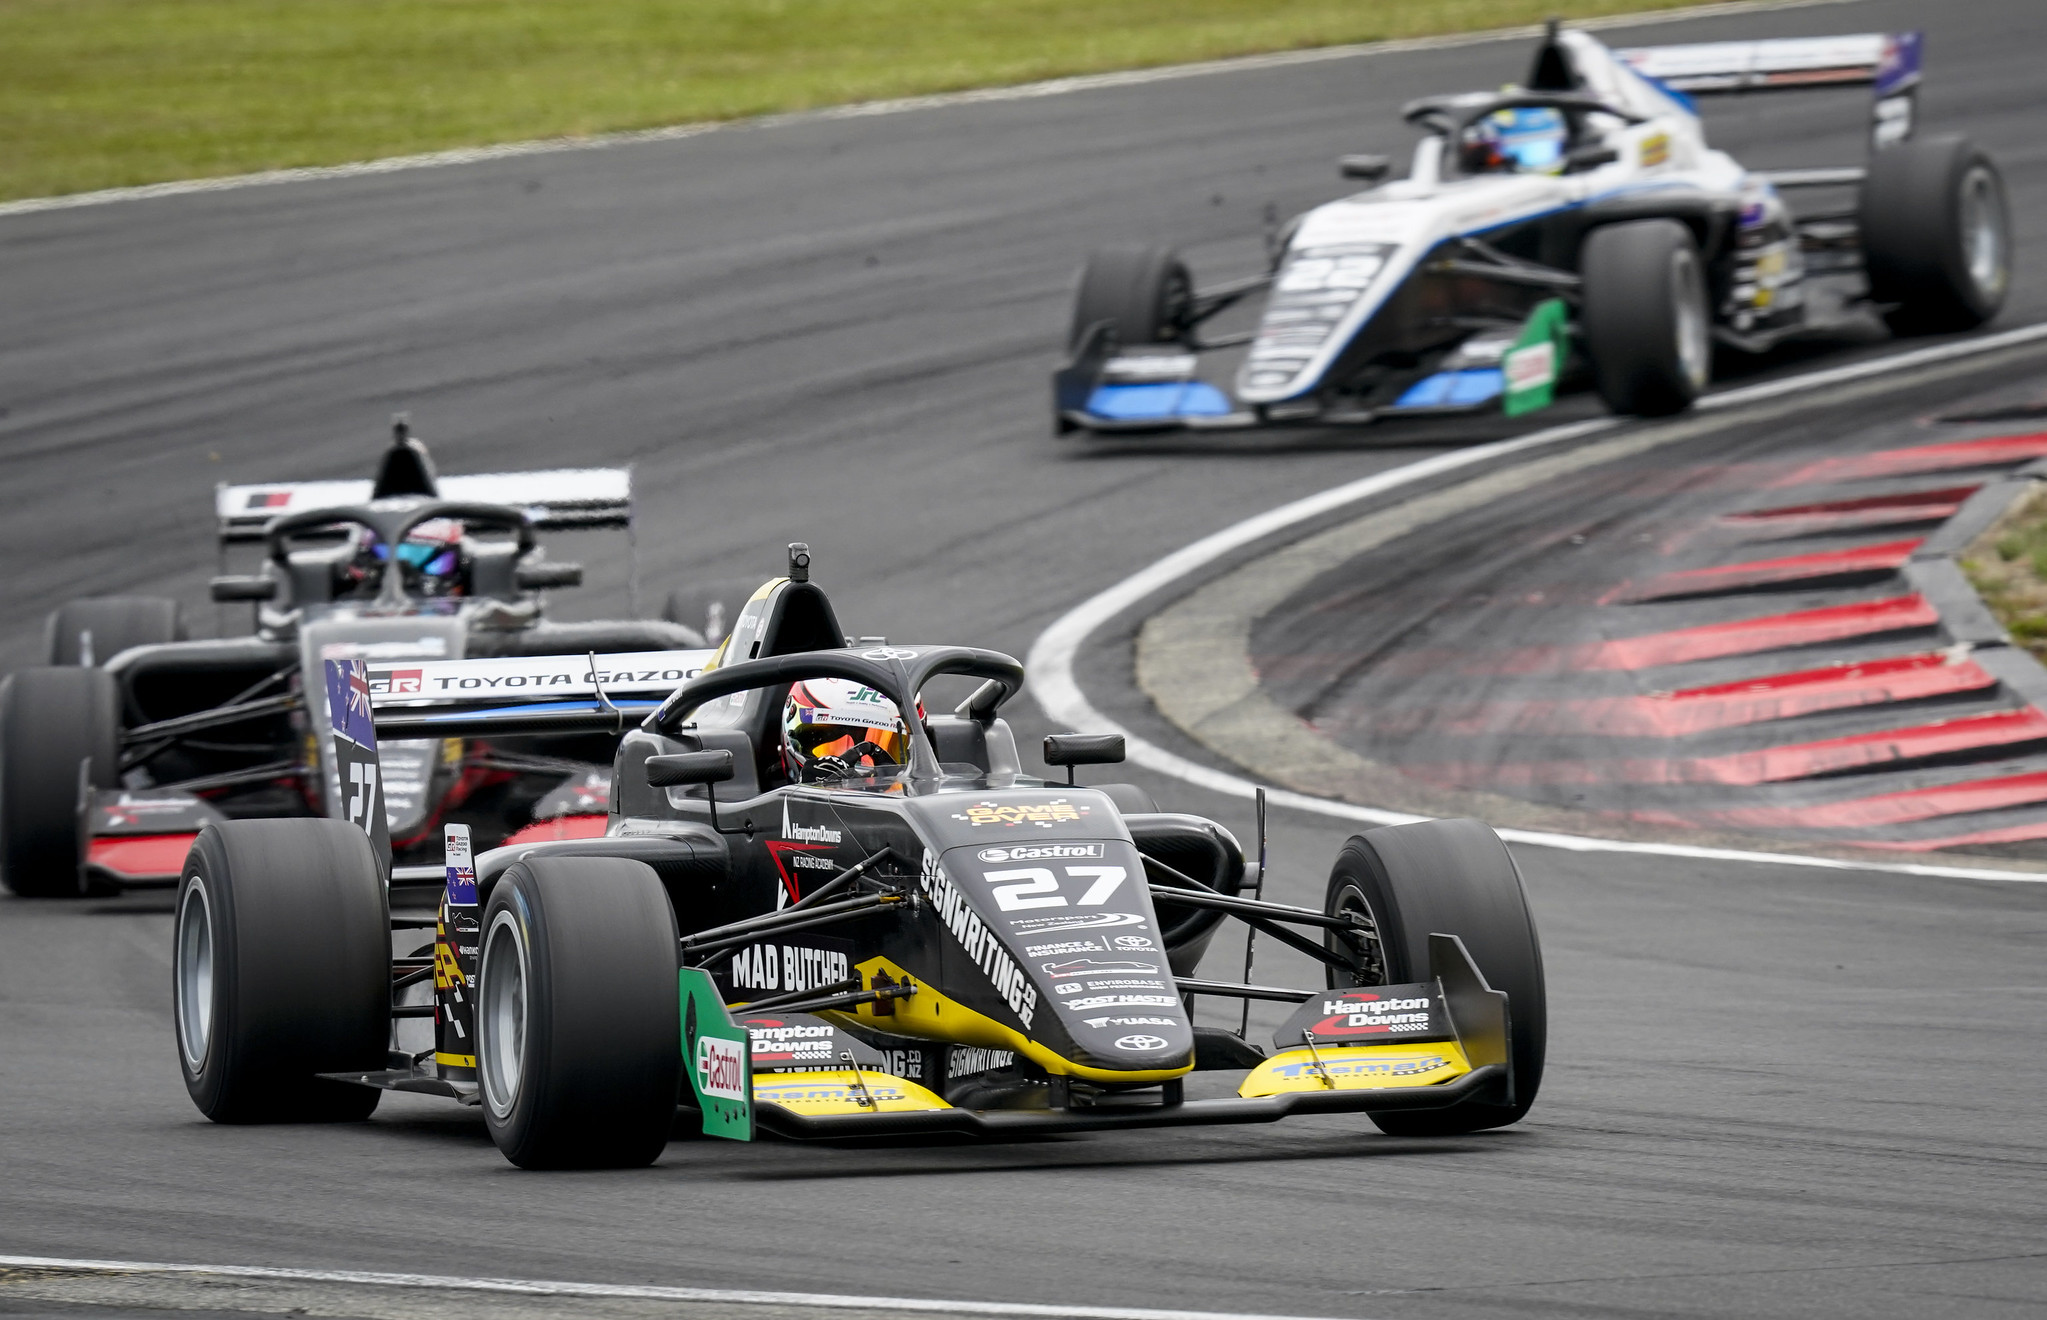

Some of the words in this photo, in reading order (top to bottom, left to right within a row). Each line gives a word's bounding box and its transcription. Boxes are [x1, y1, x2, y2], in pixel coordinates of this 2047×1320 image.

[433, 674, 572, 690] TOYOTA
[830, 715, 860, 723] TOYOTA
[862, 718, 889, 728] GAZOO
[350, 762, 376, 837] 27
[966, 804, 1077, 816] GAME
[970, 812, 1080, 823] OVER
[1010, 845, 1098, 860] Castrol
[982, 865, 1127, 912] 27
[1009, 913, 1099, 925] Motorsport
[921, 847, 1025, 1013] SIGNWRITING
[1025, 940, 1081, 952] FINANCE
[1028, 945, 1105, 958] INSURANCE
[732, 943, 779, 990] MAD
[783, 945, 848, 996] BUTCHER
[1086, 979, 1162, 987] ENVIROBASE
[1069, 995, 1117, 1007] POST
[1119, 994, 1177, 1005] HASTE
[1323, 997, 1430, 1015] Hampton
[1110, 1017, 1178, 1027] YUASA
[1348, 1012, 1430, 1027] Downs
[750, 1025, 834, 1042] ampton
[751, 1039, 833, 1054] Downs
[906, 1050, 921, 1063] .CO
[709, 1044, 742, 1092] Castrol
[906, 1063, 922, 1079] .NZ
[757, 1086, 897, 1100] asman
